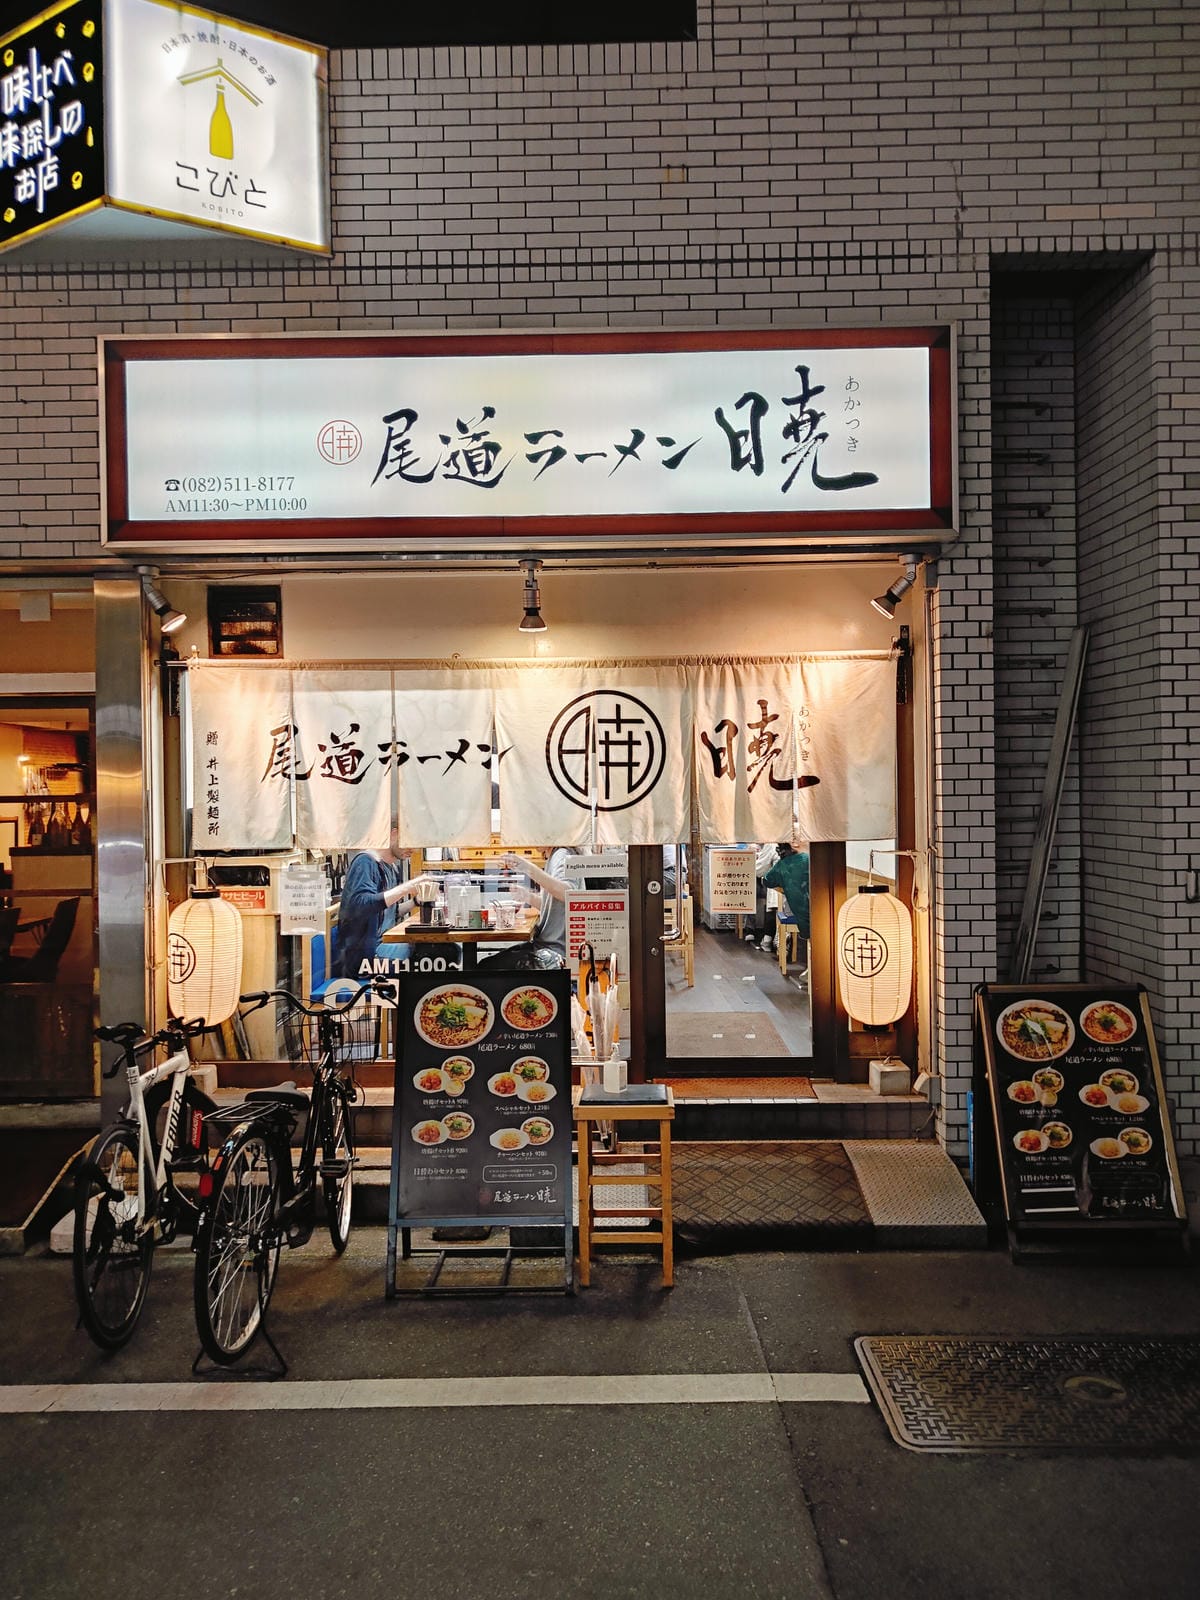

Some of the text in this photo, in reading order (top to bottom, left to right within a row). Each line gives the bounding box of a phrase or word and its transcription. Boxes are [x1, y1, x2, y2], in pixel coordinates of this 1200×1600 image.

[2, 46, 75, 115] 味比べ
[15, 147, 59, 213] お店
[176, 161, 267, 208] こびと
[202, 202, 244, 217] KOBITO
[843, 375, 861, 453] あかつき
[182, 476, 295, 493] (082)511-8177
[260, 722, 515, 785] 尾道ラーメン
[220, 891, 264, 900] サヒビール
[478, 1043, 517, 1052] 尾道ラーメン
[1065, 1056, 1103, 1064] 尾道ラーメン
